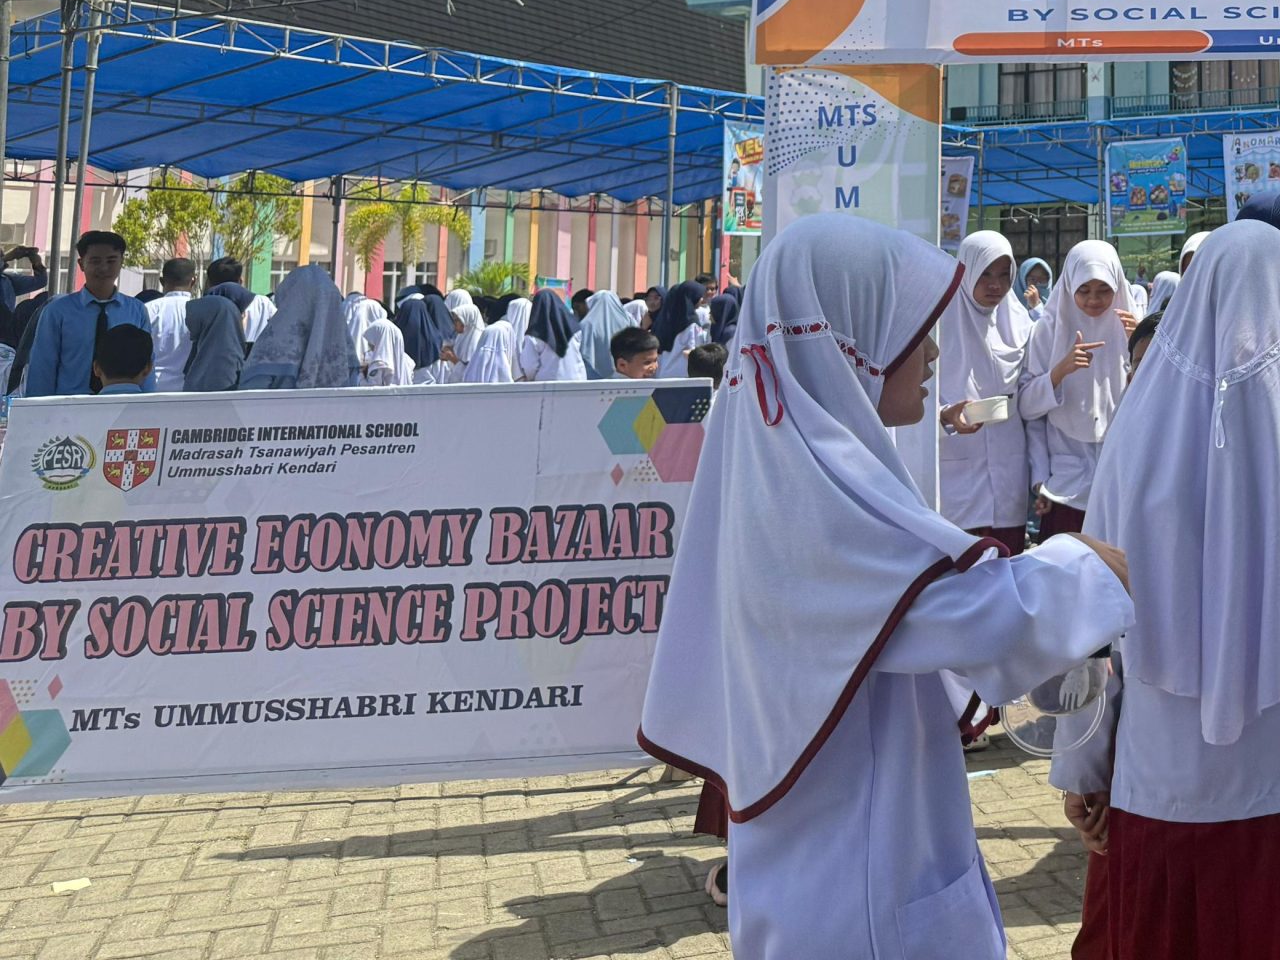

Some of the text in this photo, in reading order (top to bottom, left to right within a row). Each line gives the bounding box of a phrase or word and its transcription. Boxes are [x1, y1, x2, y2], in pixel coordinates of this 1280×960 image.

[1008, 7, 1054, 22] BY
[1071, 6, 1207, 21] SOCIAL
[1057, 38, 1103, 48] MTs
[818, 103, 877, 129] MTS
[171, 422, 420, 444] CAMBRIDGE INTERNATIONAL SCHOOL
[169, 442, 416, 461] Madrasah Tsanawiyah Pesantren
[167, 461, 337, 478] Ummusshabri Kendari
[13, 501, 677, 584] CREATIVE ECONOMY BAZAAR
[0, 575, 670, 664] BY SOCIAL SCIENCE PROJECT
[69, 684, 584, 732] MTs UMMUSSHABRI KENDARI
